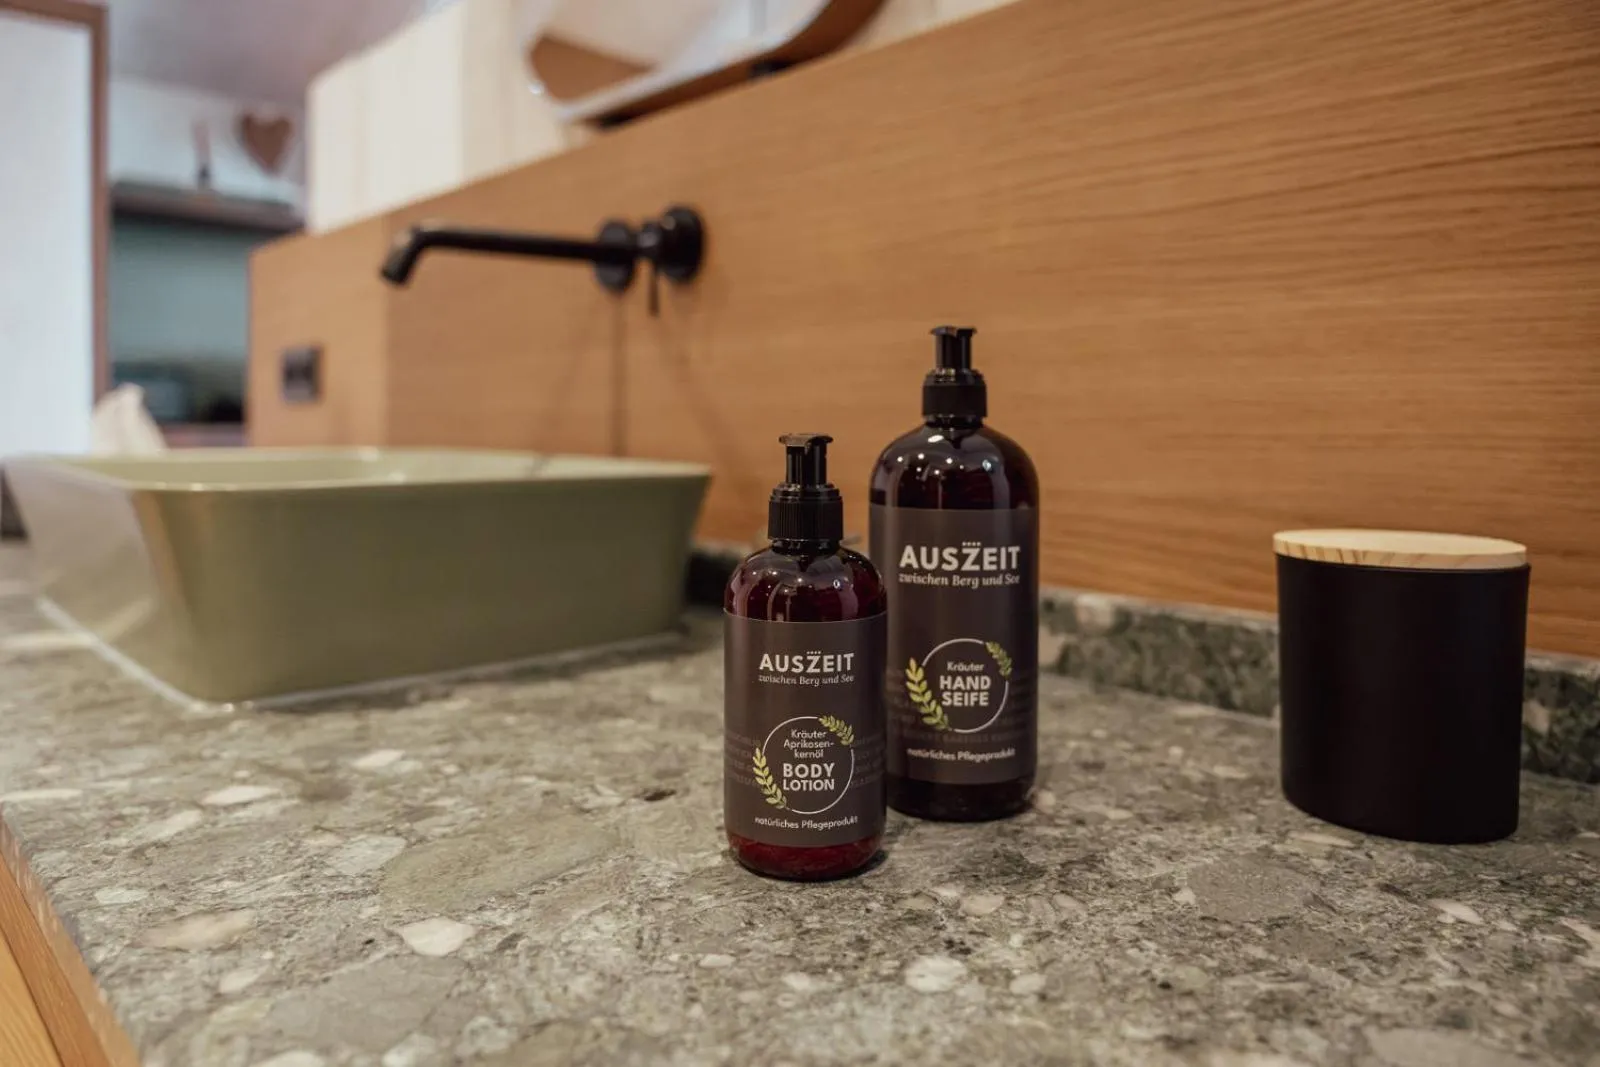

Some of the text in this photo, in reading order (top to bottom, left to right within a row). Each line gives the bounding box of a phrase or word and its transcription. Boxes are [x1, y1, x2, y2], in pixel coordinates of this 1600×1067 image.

[952, 575, 979, 589] Berg
[982, 575, 1003, 586] und
[947, 661, 985, 671] Kräuter
[758, 675, 854, 686] zwischen Berg und See
[940, 676, 990, 690] HAND
[941, 691, 989, 706] SEIFE
[791, 729, 827, 739] Kräuter
[784, 739, 834, 750] Aprikosen-
[794, 750, 824, 758] kernöl
[907, 748, 1015, 763] natürliches Pflegeprodukt
[783, 763, 835, 778] BODY
[783, 779, 835, 791] LOTION
[755, 816, 858, 831] natürliches Pflegeprodukt
